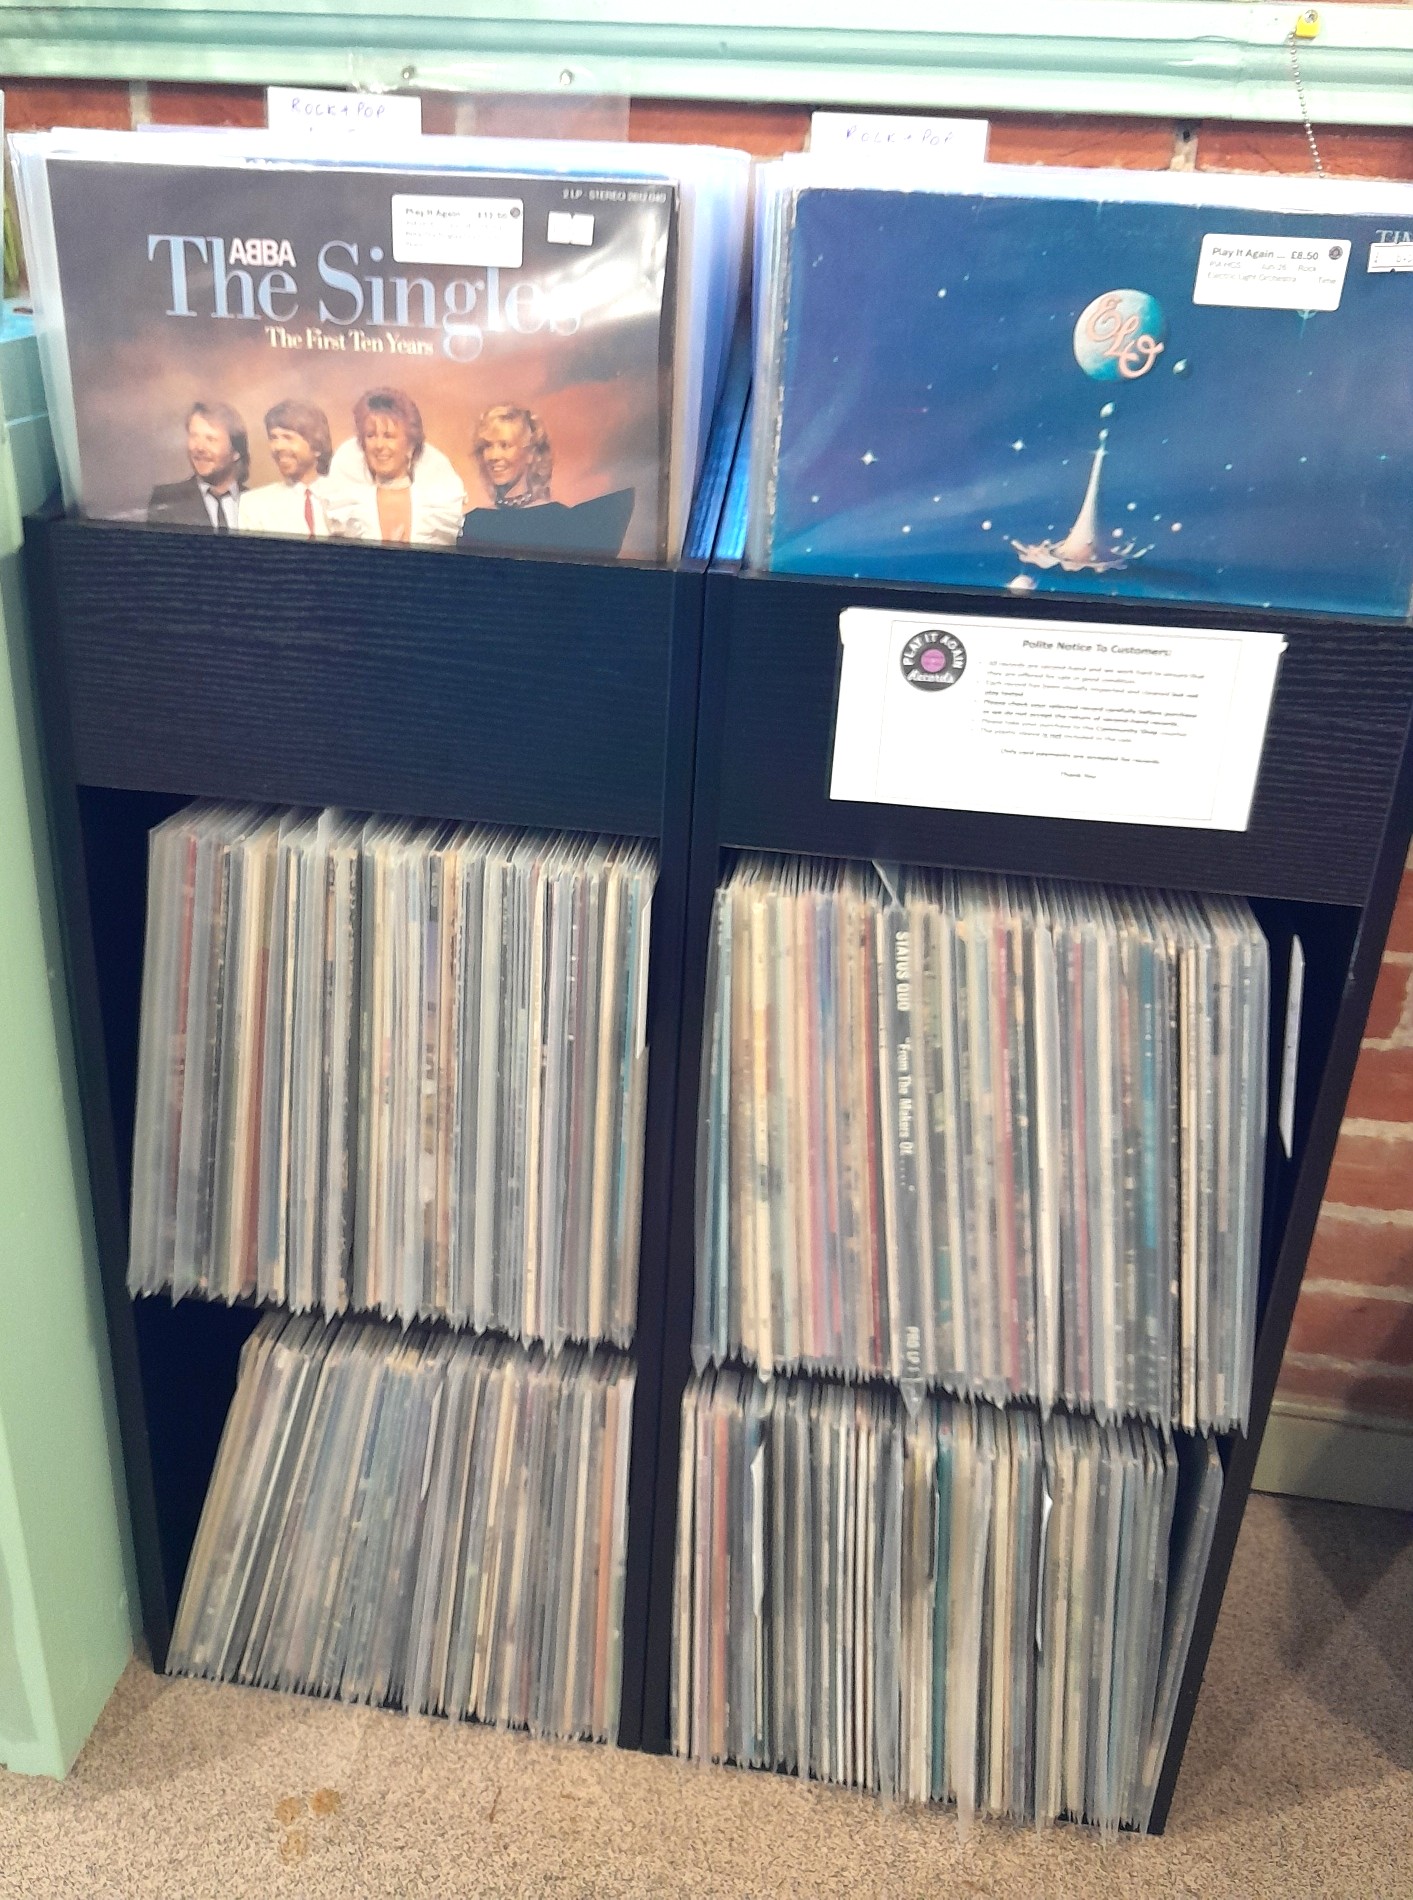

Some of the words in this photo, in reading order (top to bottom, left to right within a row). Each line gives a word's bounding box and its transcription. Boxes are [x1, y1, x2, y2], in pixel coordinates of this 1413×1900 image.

[291, 97, 337, 116] ROCK
[357, 101, 386, 118] POP
[229, 238, 297, 268] ABBA
[1211, 247, 1233, 259] Play
[1235, 248, 1244, 257] It
[1245, 248, 1274, 260] Again
[1290, 250, 1320, 261] £8.50
[147, 233, 299, 323] The
[264, 325, 303, 350] The
[305, 329, 345, 352] First
[347, 331, 384, 354] Ten
[385, 332, 434, 356] Years
[1086, 294, 1165, 378] ELO
[902, 635, 923, 666] PLAY
[924, 631, 939, 643] IT
[939, 634, 965, 669] AGAIN
[1022, 639, 1054, 650] Polite
[1056, 641, 1092, 652] Notice
[1096, 643, 1108, 653] To
[895, 930, 911, 980] STATUS
[896, 982, 911, 1012] QUO
[898, 1075, 913, 1095] The
[898, 1098, 914, 1139] Makers
